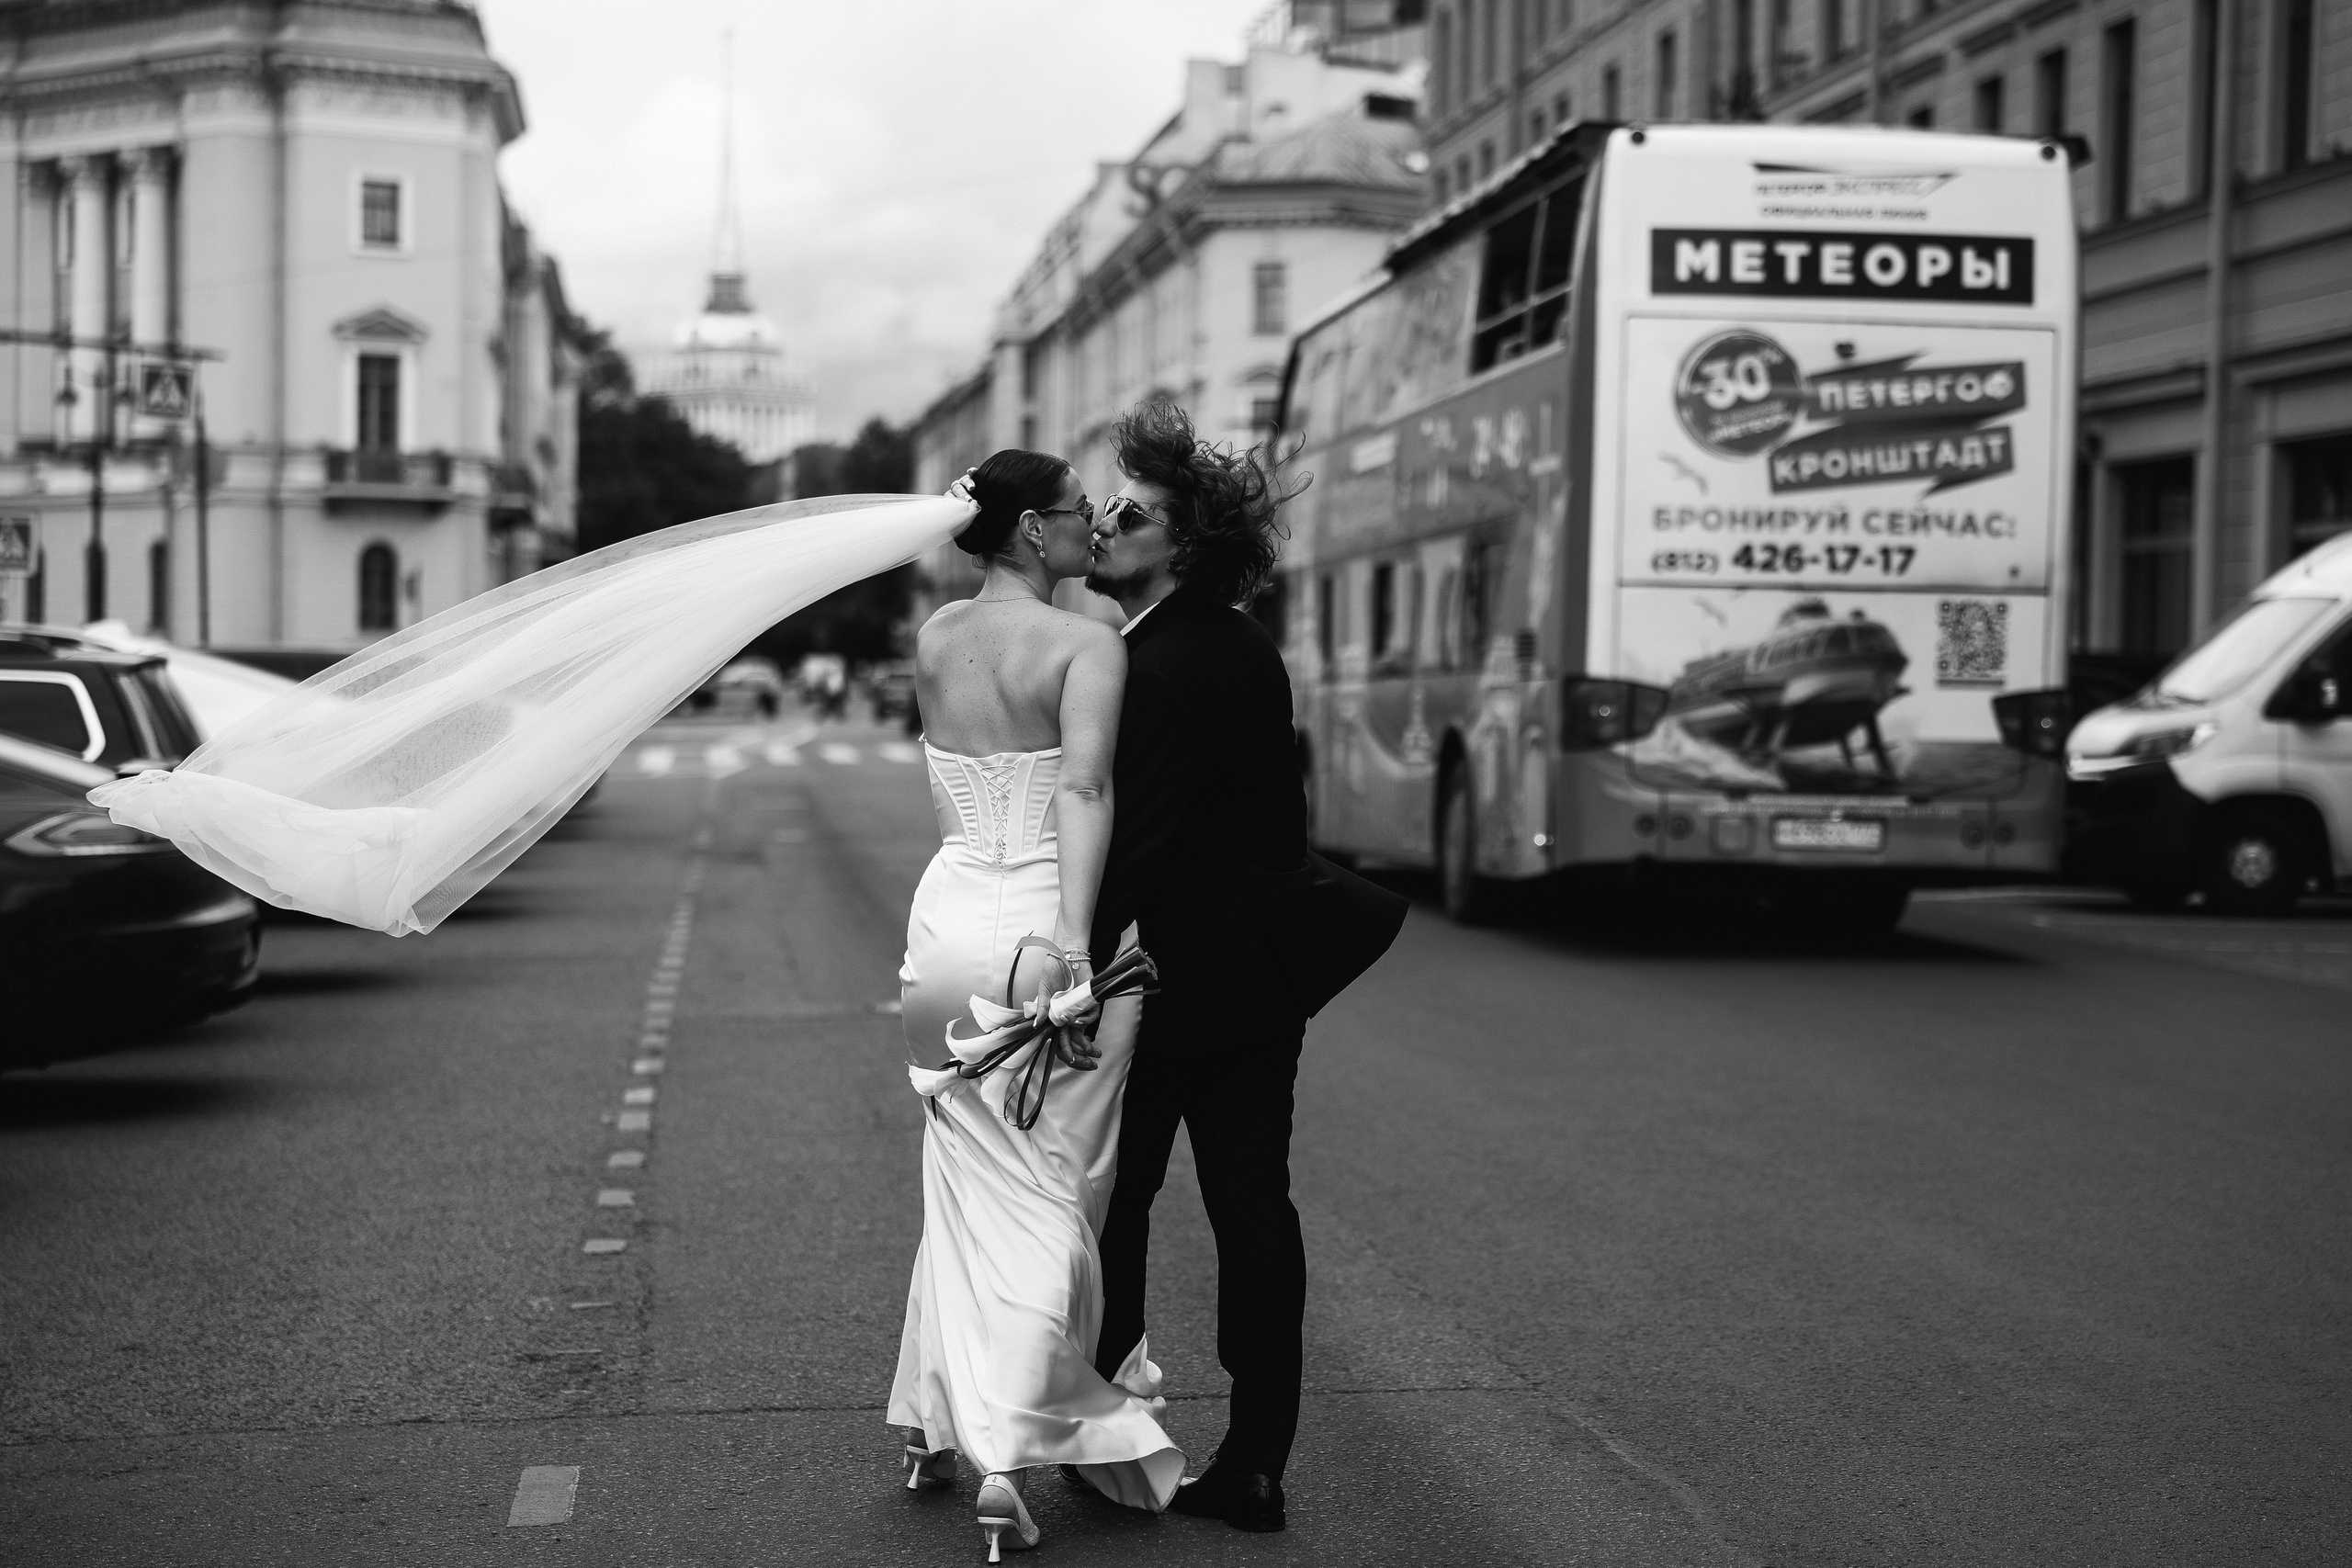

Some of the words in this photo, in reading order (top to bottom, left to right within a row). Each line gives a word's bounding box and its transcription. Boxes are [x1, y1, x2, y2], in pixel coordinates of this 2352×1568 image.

[1674, 237, 2011, 291] МЕТЕОРЫ
[1816, 369, 2015, 412] ПЕТЕРГОФ
[1773, 434, 2007, 485] КРОНШТАДТ
[1654, 502, 1849, 534] БРОНИРУЙ
[1862, 505, 2018, 539] СЕЙЧАС:
[1651, 551, 1719, 575] (812)
[1732, 543, 1917, 576] 426-17-17
